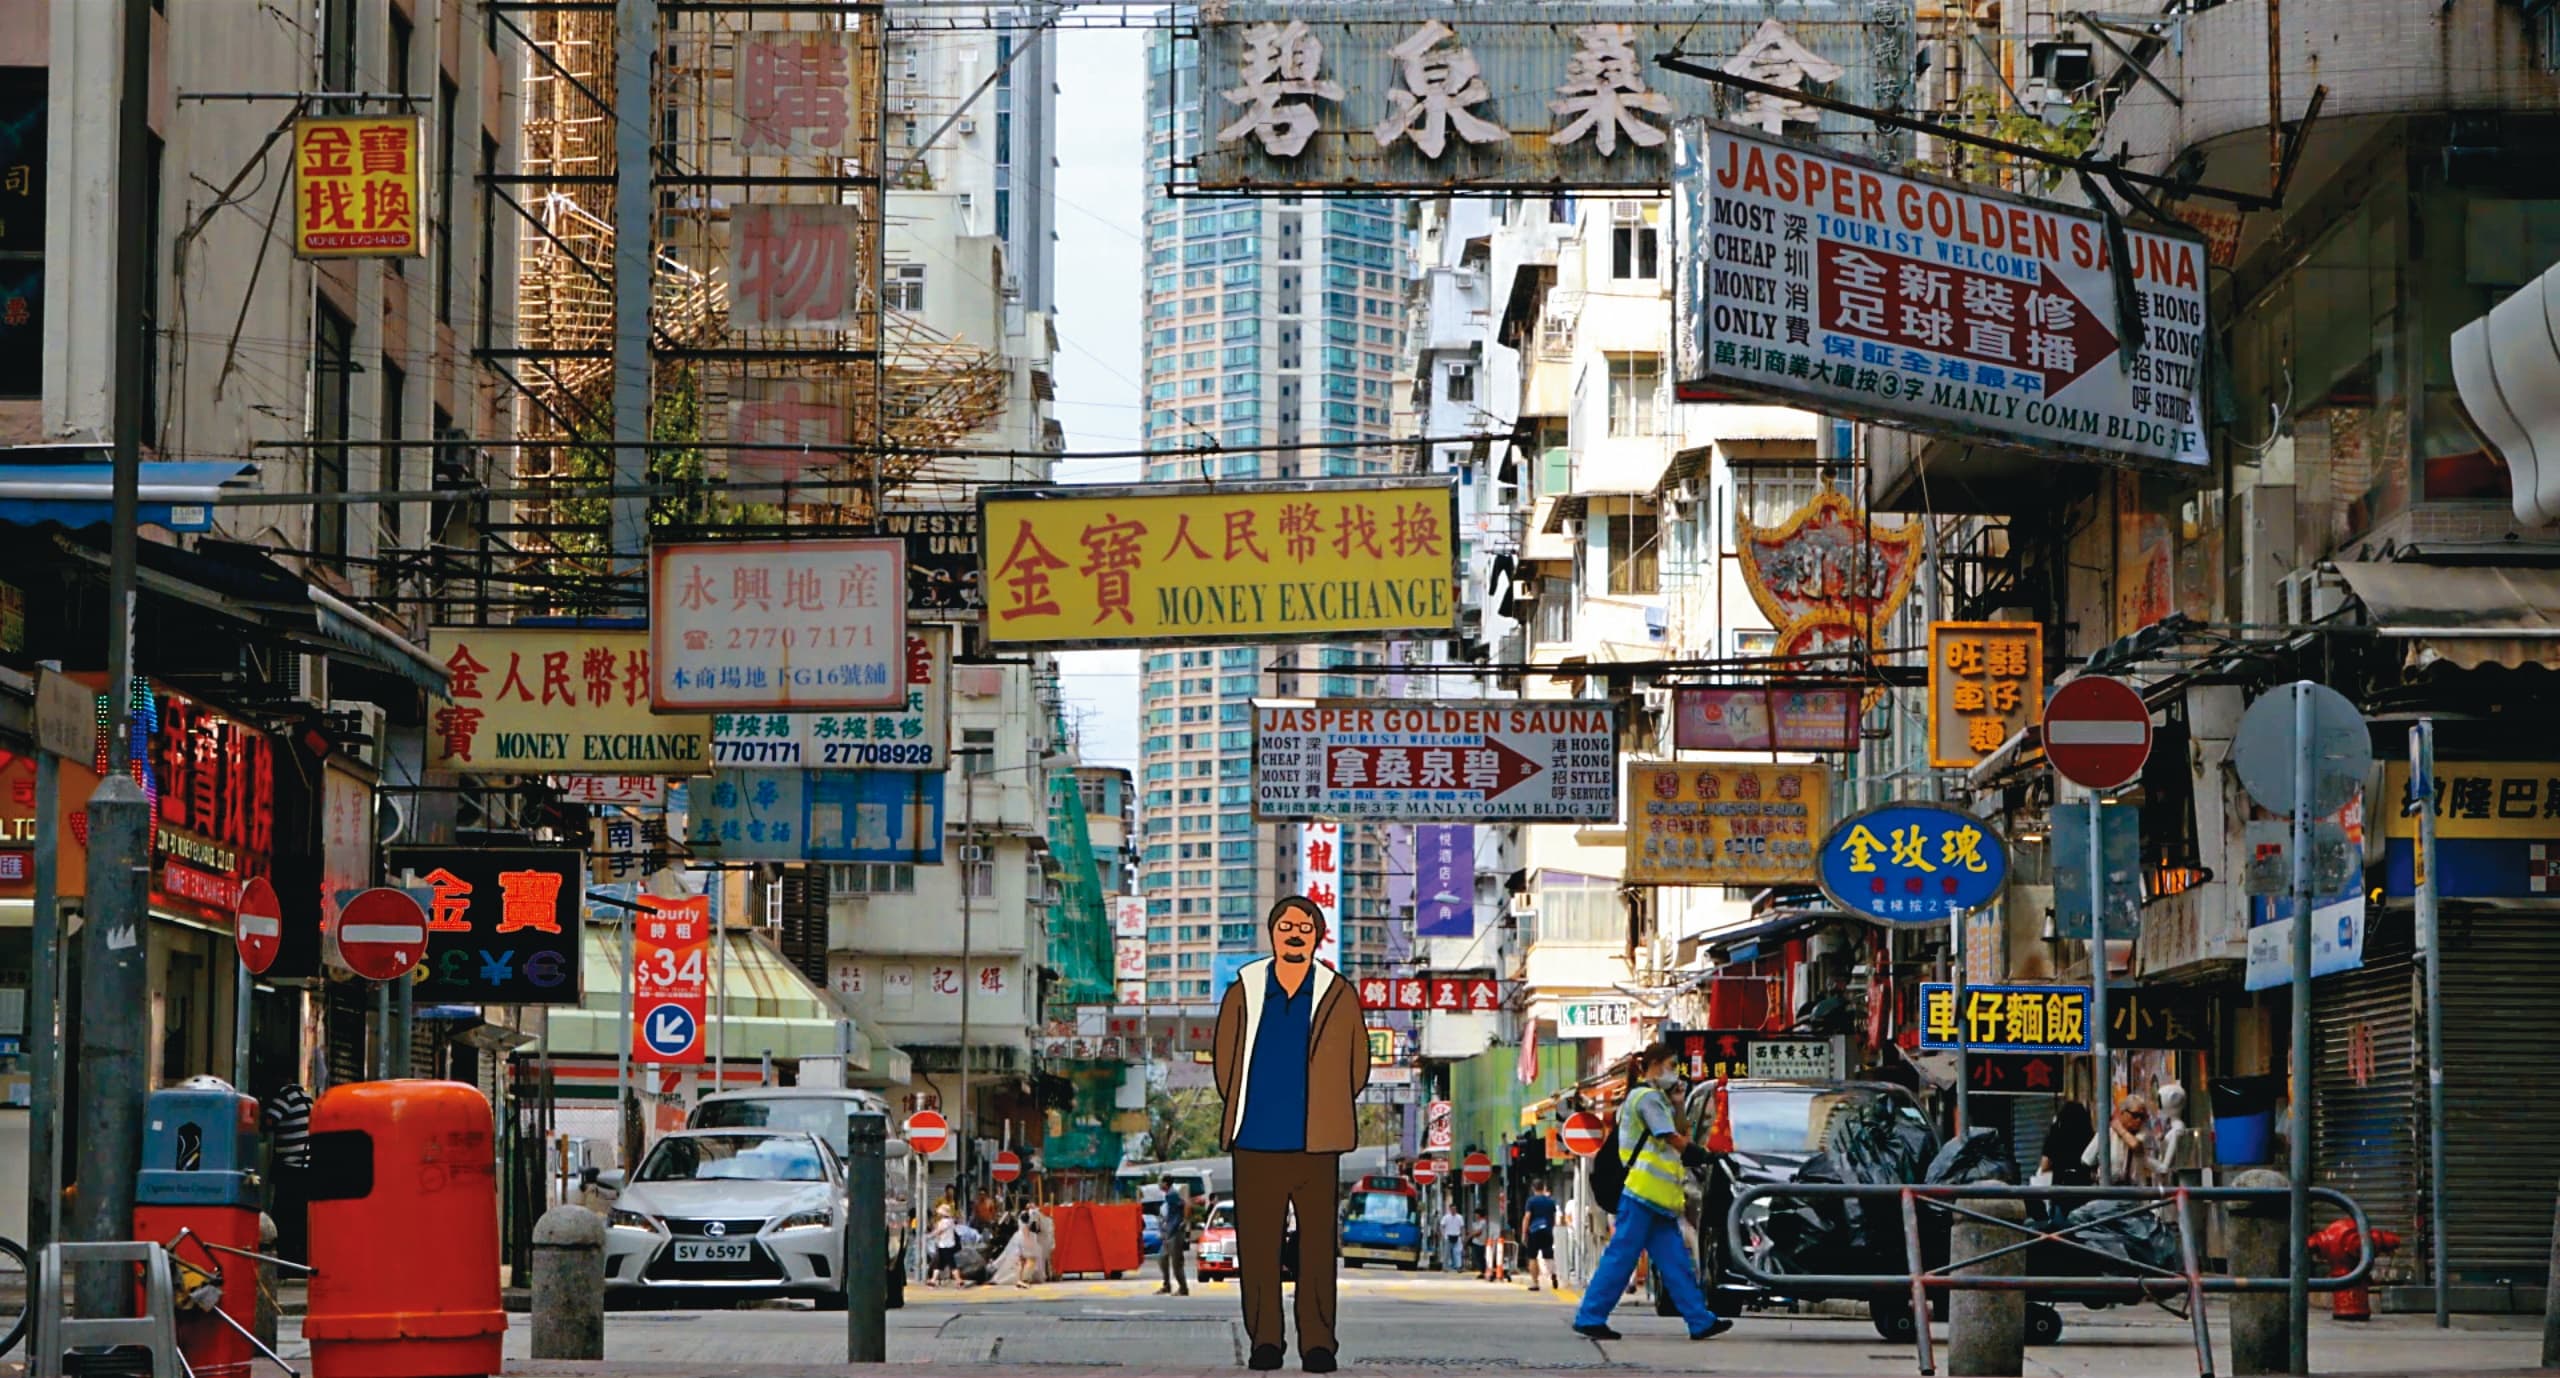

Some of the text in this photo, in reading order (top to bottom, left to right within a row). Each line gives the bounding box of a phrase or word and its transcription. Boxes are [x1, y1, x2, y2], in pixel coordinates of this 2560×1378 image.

[303, 124, 409, 177] 金寶
[304, 179, 410, 230] 找換
[1713, 196, 1776, 235] MOST
[1716, 141, 1886, 224] JASPER
[1896, 183, 2060, 263] GOLDEN
[1713, 233, 1777, 270] CHEAP
[1816, 213, 2038, 282] TOURIST WELCOME
[1713, 268, 1777, 305] MONEY
[1831, 248, 2077, 331] 全新裝修
[1713, 304, 1777, 341] ONLY
[2153, 291, 2200, 327] HONG
[2154, 325, 2200, 360] KONG
[1932, 381, 2021, 420] MANLY
[2025, 399, 2101, 435] COMM
[2106, 414, 2167, 447] BLDG
[1161, 501, 1444, 566] 人民幣找換
[994, 512, 1150, 626] 金寶
[1156, 577, 1448, 627] MONEY EXCHANGE
[727, 623, 874, 650] 2770 7171
[1952, 679, 2022, 713] 車仔
[1263, 708, 1609, 734] JASPER GOLDEN SAUNA
[495, 732, 701, 762] MONEY EXCHANGE
[823, 743, 933, 765] 27708928
[1261, 736, 1301, 750] MOST
[1327, 734, 1483, 746] TOURIST WELCOME
[1570, 738, 1610, 751] HONG
[1261, 753, 1301, 766] CHEAP
[1261, 769, 1301, 783] MONEY
[1570, 754, 1610, 768] KONG
[1261, 785, 1301, 799] ONLY
[1570, 771, 1610, 785] STYLE
[1570, 787, 1610, 801] SERVICE
[1405, 802, 1611, 815] MANLY COMM BLDG 3/F
[1840, 823, 1988, 873] 金玫瑰
[423, 867, 563, 934] 金寶
[637, 947, 705, 987] $34
[1926, 990, 2085, 1045] 車仔麵飯
[1973, 1057, 2054, 1089] 小食
[679, 1245, 747, 1259] SV 6597
